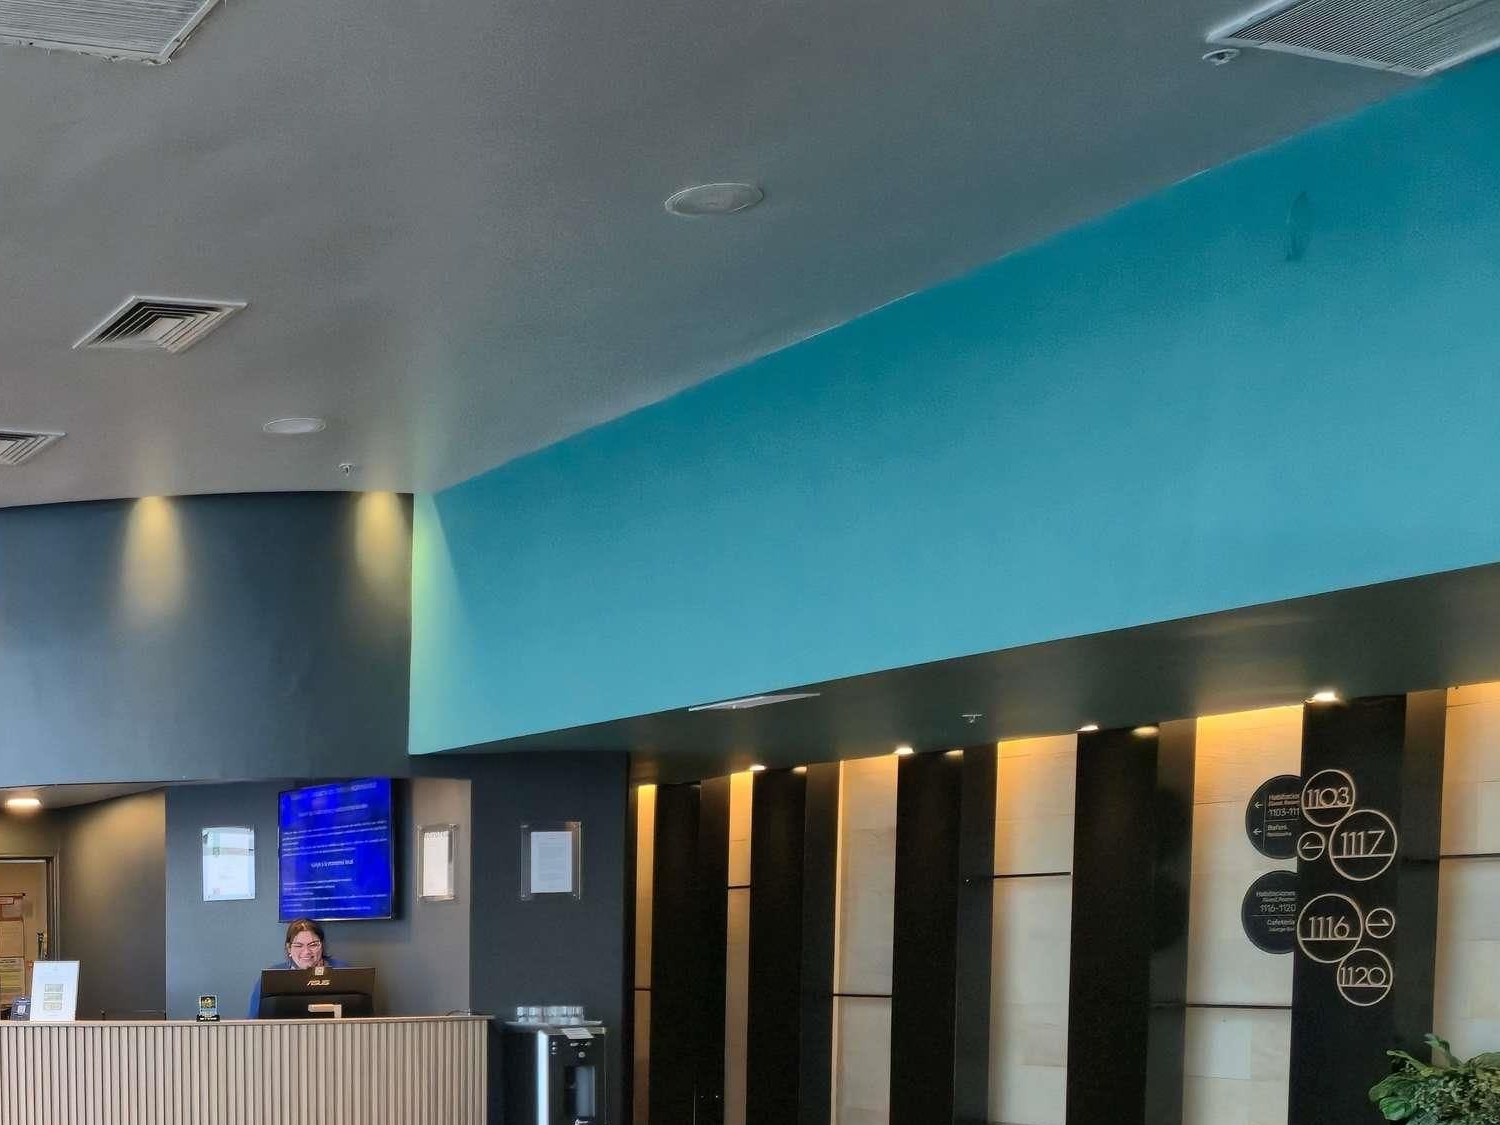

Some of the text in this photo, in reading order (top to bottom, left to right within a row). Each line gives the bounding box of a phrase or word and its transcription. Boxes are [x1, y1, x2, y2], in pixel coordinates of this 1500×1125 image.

[1307, 787, 1349, 807] 1103
[1341, 830, 1385, 856] 1117
[1309, 916, 1350, 938] 1116
[1340, 966, 1386, 986] 1120
